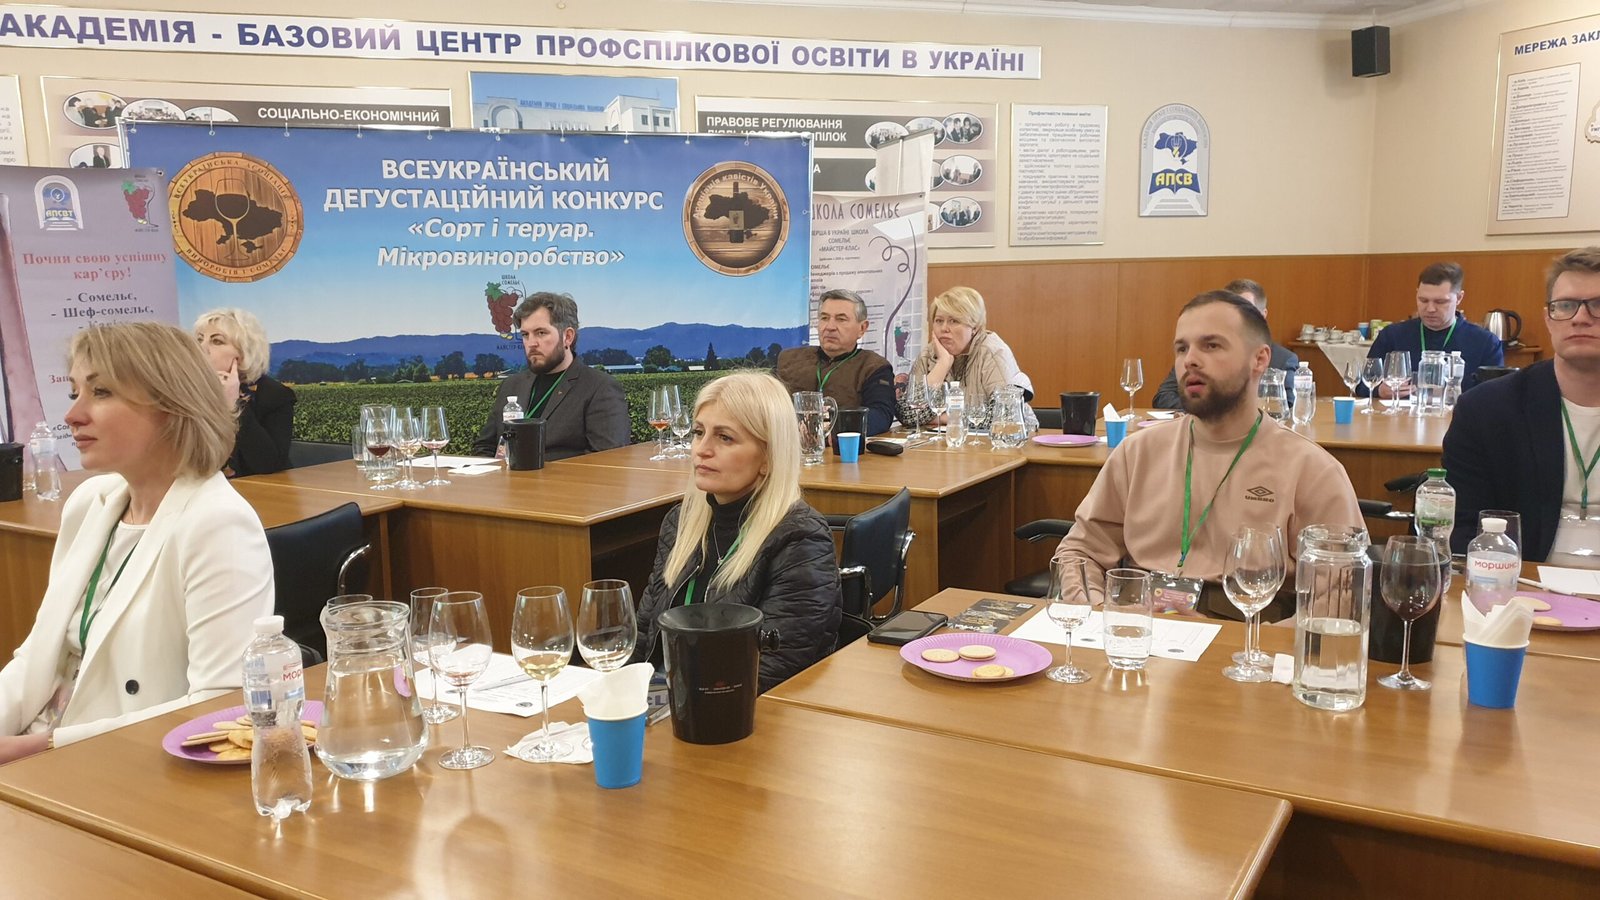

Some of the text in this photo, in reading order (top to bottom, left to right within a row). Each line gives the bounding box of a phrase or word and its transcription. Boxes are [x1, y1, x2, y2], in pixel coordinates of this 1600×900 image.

[0, 13, 196, 45] АКАДЕМІЯ
[237, 23, 401, 51] БАЗОВИЙ
[416, 29, 522, 56] ЦЕНТР
[536, 34, 780, 66] ПРОФСПІЛКОВОЇ
[791, 45, 890, 69] ОСВІТИ
[902, 49, 918, 70] В
[928, 48, 1025, 72] УКРАЇНІ
[1514, 36, 1568, 56] МЕРЕЖА
[257, 107, 440, 123] СОЦІАЛЬНО-ЕКОНОМІЧНИЙ
[706, 116, 843, 129] ПРАВОВЕ РЕГУЛЮВАННЯ
[815, 131, 847, 142] ПІЛОК
[381, 156, 611, 182] ВСЕУКРАЇНСЬКИЙ
[1155, 172, 1194, 187] АПСВ
[323, 184, 664, 212] ДЕГУСТАЦІЙНИЙ КОНКУРС
[849, 202, 901, 220] СОМЕЛЬЄ
[407, 217, 595, 243] «Сорт і теруар.
[23, 251, 168, 266] Почни свою успішну
[376, 246, 626, 270] Мікровиноробство»
